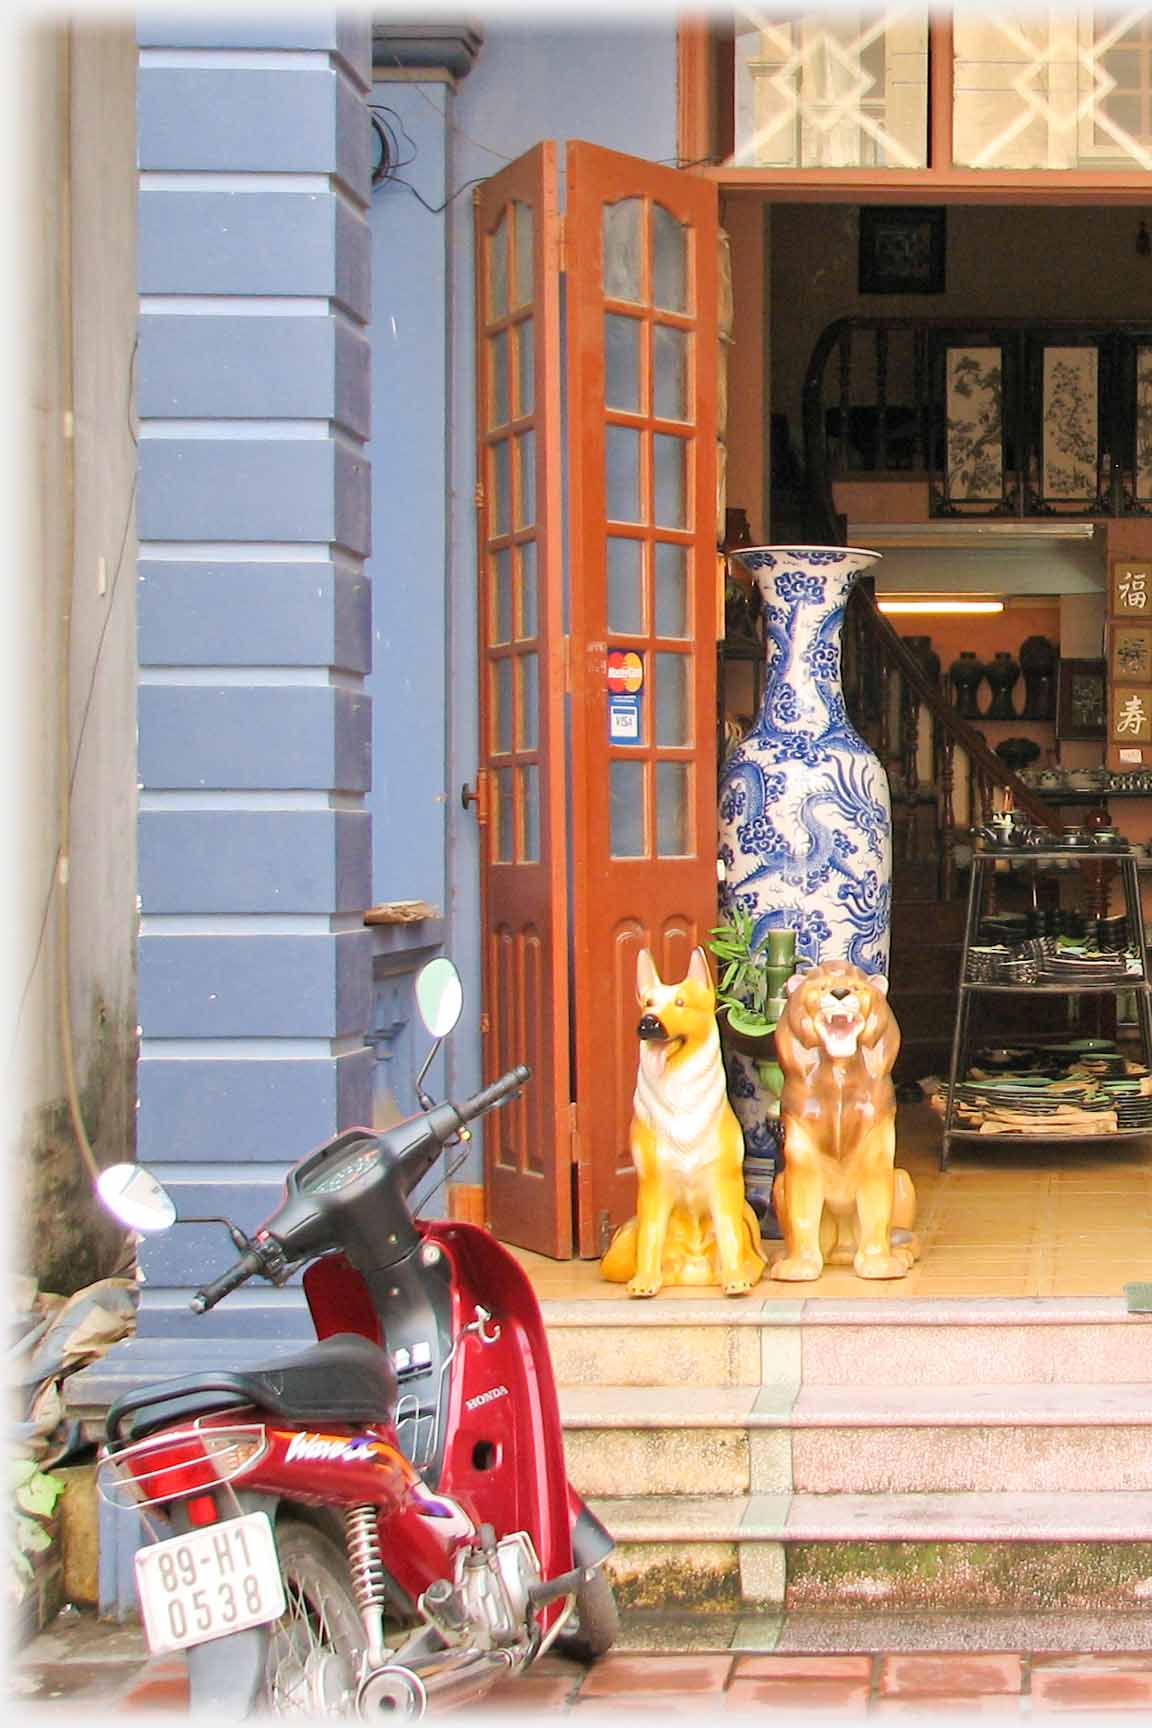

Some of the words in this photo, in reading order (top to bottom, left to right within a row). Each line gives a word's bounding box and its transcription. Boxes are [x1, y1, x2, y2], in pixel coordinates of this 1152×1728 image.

[1118, 571, 1147, 609] 福
[1117, 695, 1148, 735] 寿
[465, 1385, 509, 1410] HONDA
[157, 1527, 253, 1593] 89-H1
[167, 1574, 263, 1639] 0538
